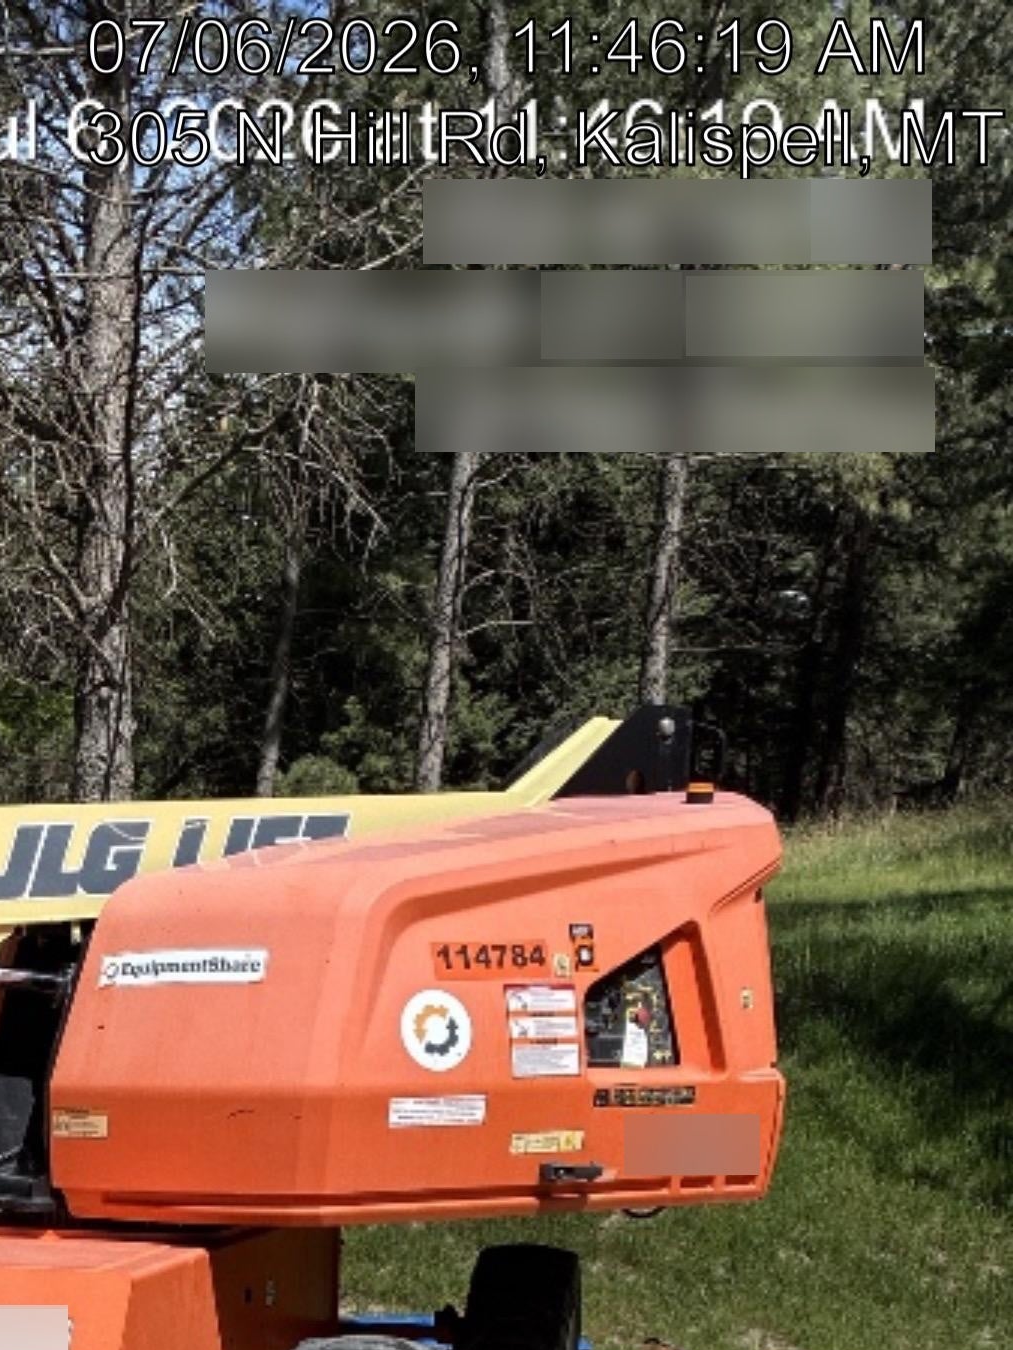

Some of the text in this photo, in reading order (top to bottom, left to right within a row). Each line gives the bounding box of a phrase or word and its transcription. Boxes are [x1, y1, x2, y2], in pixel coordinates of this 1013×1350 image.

[172, 813, 353, 867] LI
[121, 956, 261, 978] EquipmentShare
[437, 944, 546, 969] 114784
